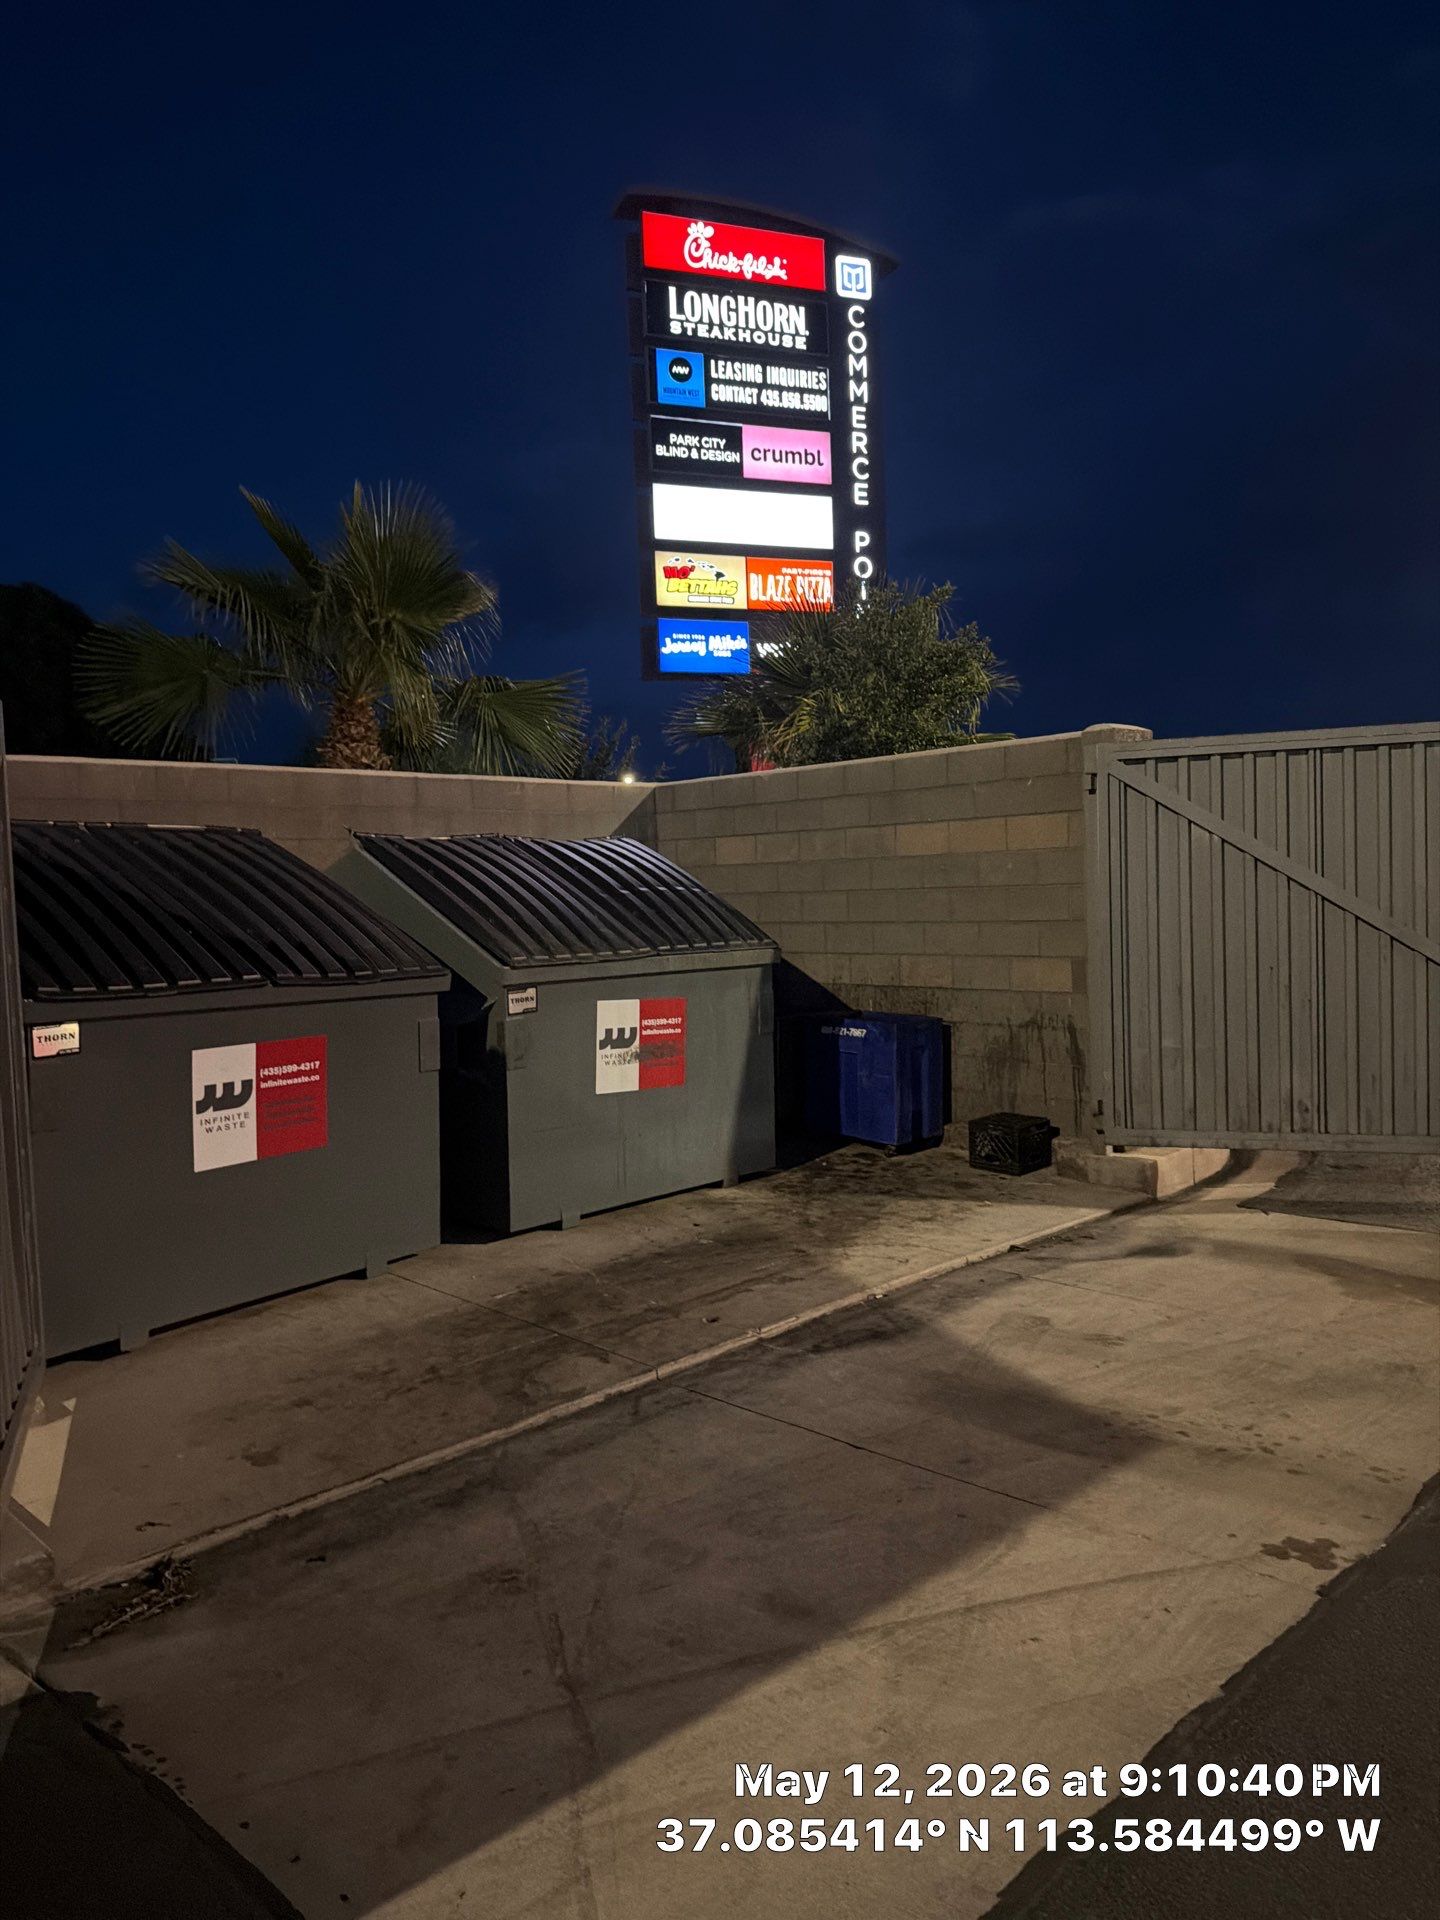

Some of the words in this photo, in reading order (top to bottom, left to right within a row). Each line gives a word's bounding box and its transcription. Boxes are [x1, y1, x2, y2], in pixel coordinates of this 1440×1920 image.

[684, 221, 788, 280] Chick-fil-A
[669, 321, 807, 350] STEAKHOUSE
[710, 359, 763, 384] LEASING
[766, 366, 827, 391] INQUIRIES
[710, 383, 758, 404] CONTACT
[847, 305, 871, 506] COMMERCE
[669, 433, 700, 447] PARK
[702, 436, 726, 449] CITY
[655, 444, 689, 458] BLIND
[690, 448, 699, 459] &
[700, 449, 740, 463] DESIGN
[750, 446, 825, 467] crumbl
[750, 573, 792, 602] BLAZE
[795, 575, 833, 603] PIZZA
[661, 637, 706, 656] Jersey
[510, 996, 534, 1004] THORN
[36, 1032, 76, 1044] THORN
[260, 1061, 321, 1078] (435)599-4317
[260, 1074, 320, 1089] infinitewaste.co
[200, 1112, 250, 1127] INFINITE
[205, 1121, 247, 1134] WASTE
